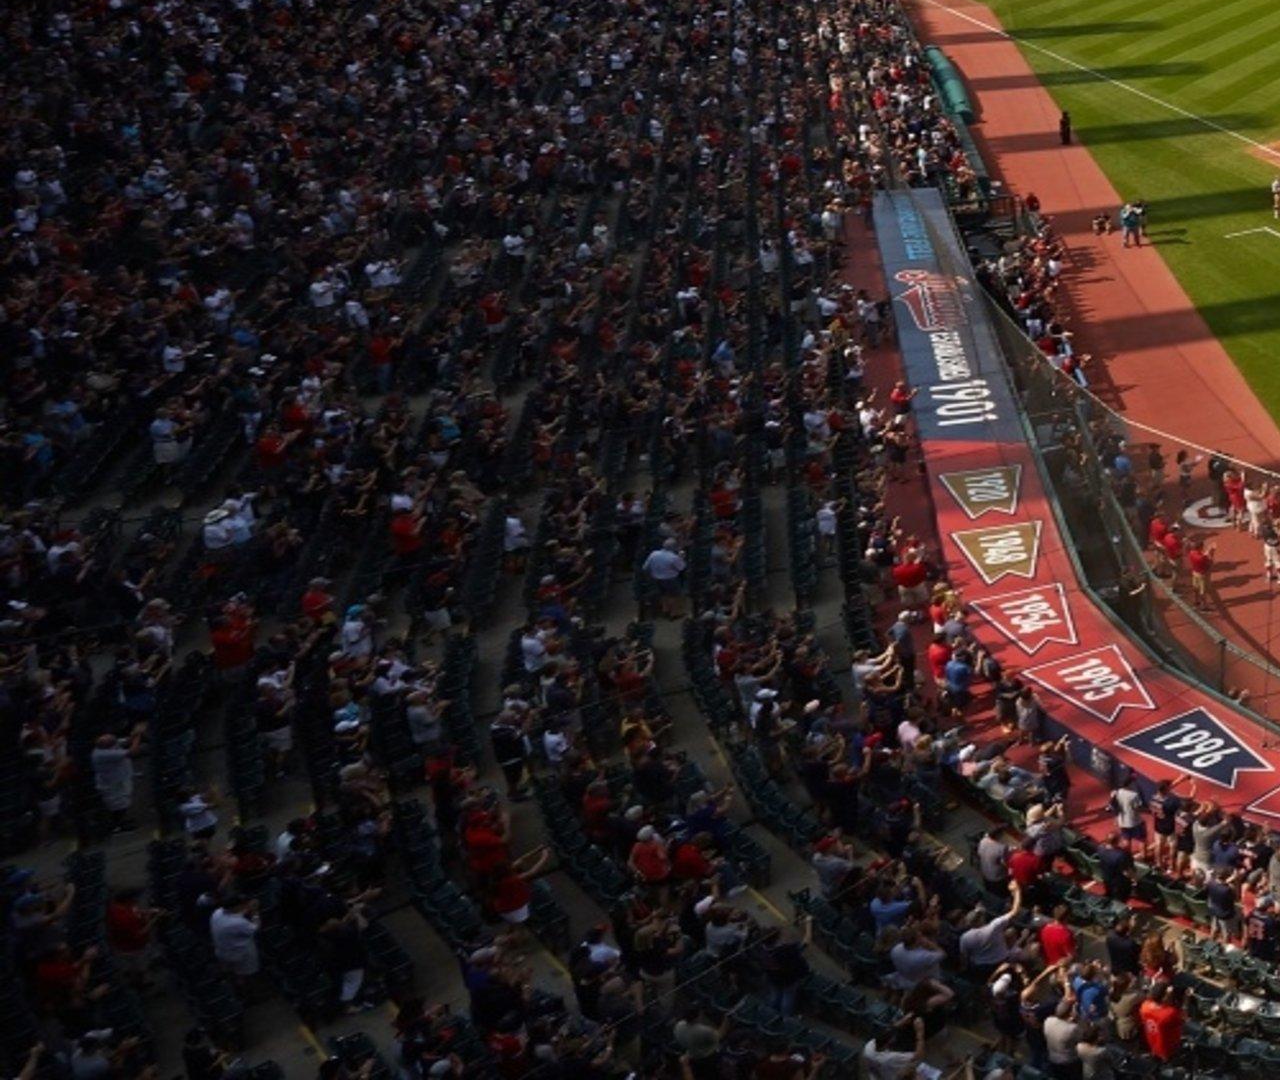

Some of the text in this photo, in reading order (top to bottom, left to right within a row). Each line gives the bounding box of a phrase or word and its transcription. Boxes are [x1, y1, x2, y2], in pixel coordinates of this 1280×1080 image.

[929, 379, 999, 427] 1901
[963, 471, 1010, 502] 1920
[977, 530, 1029, 565] 1948
[998, 594, 1062, 635] 1954
[1057, 658, 1133, 702] 1995
[1152, 720, 1241, 772] 1996
